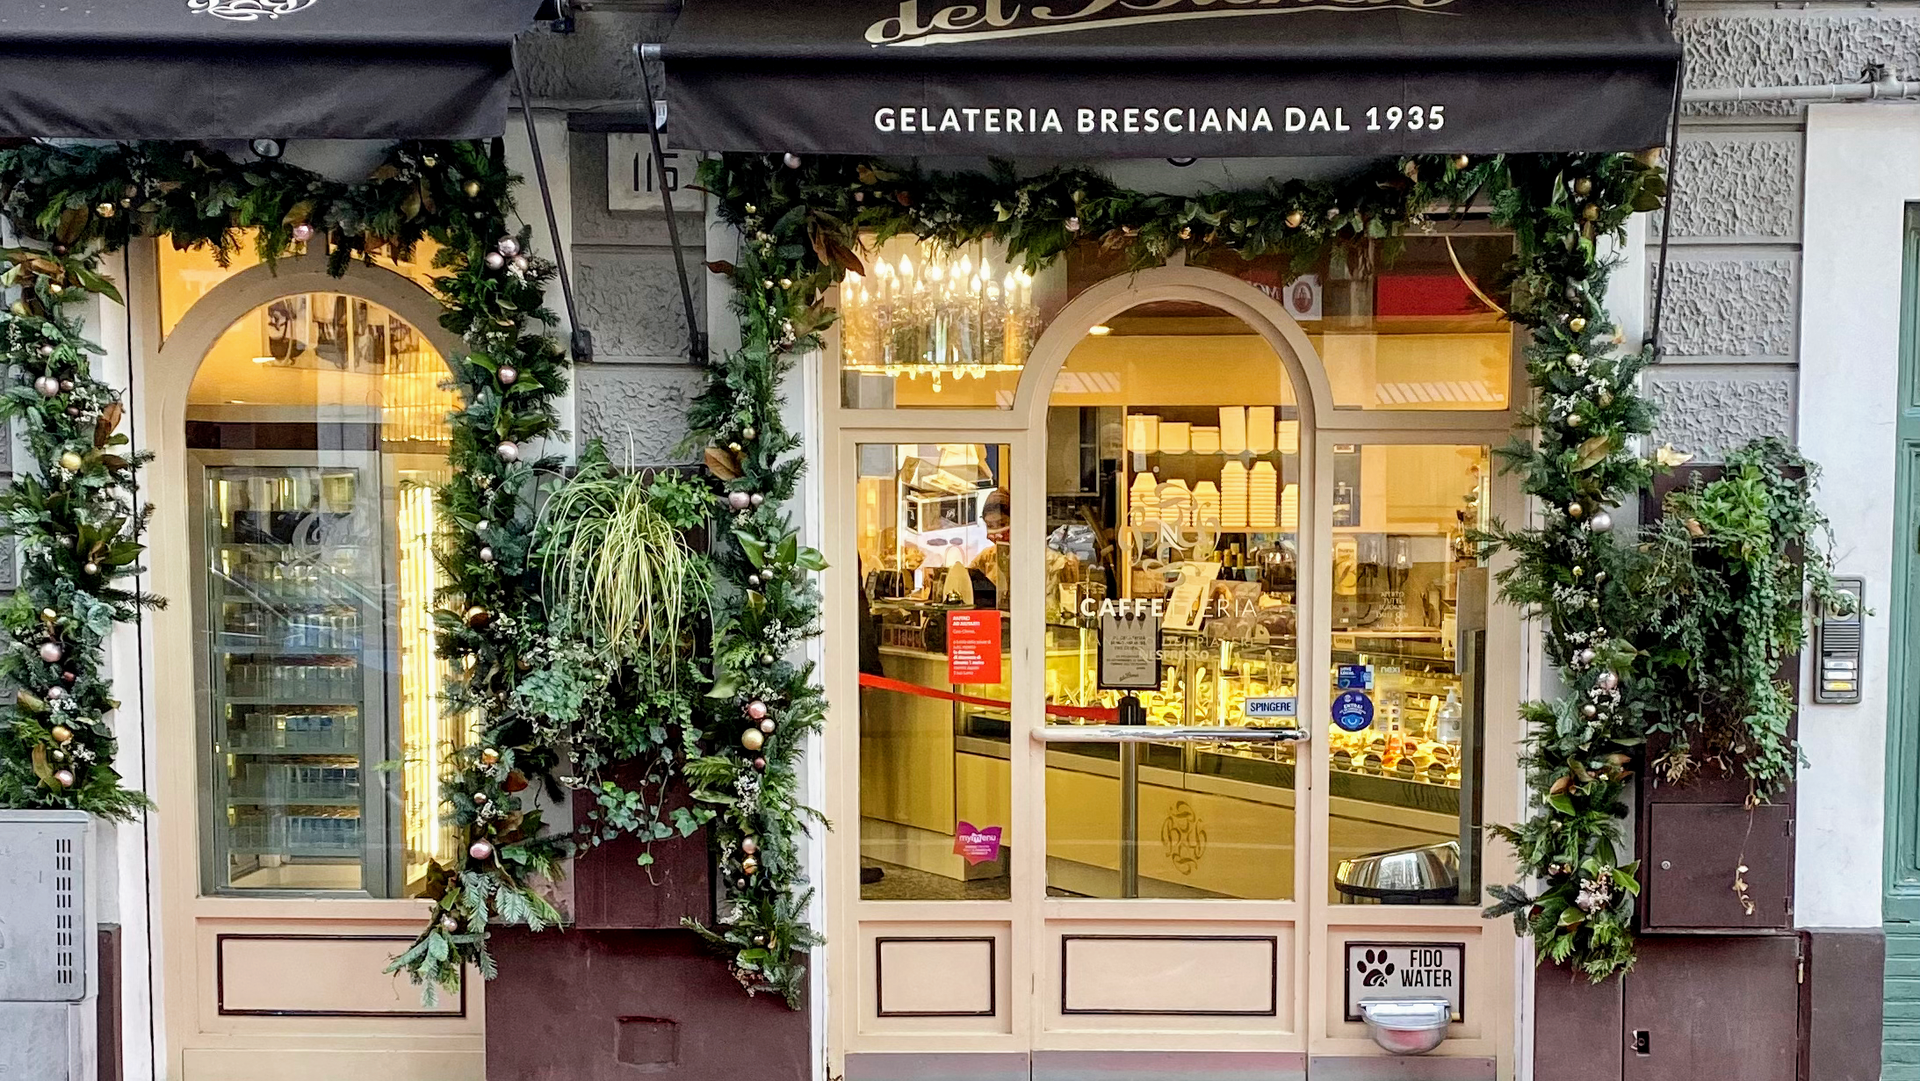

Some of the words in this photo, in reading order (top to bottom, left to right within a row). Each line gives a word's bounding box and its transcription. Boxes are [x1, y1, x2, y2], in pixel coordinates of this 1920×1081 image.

[874, 107, 1062, 132] GELATERIA
[1077, 107, 1273, 132] BRESCIANA
[1285, 107, 1350, 132] DAL
[1365, 105, 1443, 131] 1935
[1250, 702, 1292, 712] SPINGERE
[1410, 949, 1443, 968] FIDO
[1400, 969, 1452, 987] WATER
